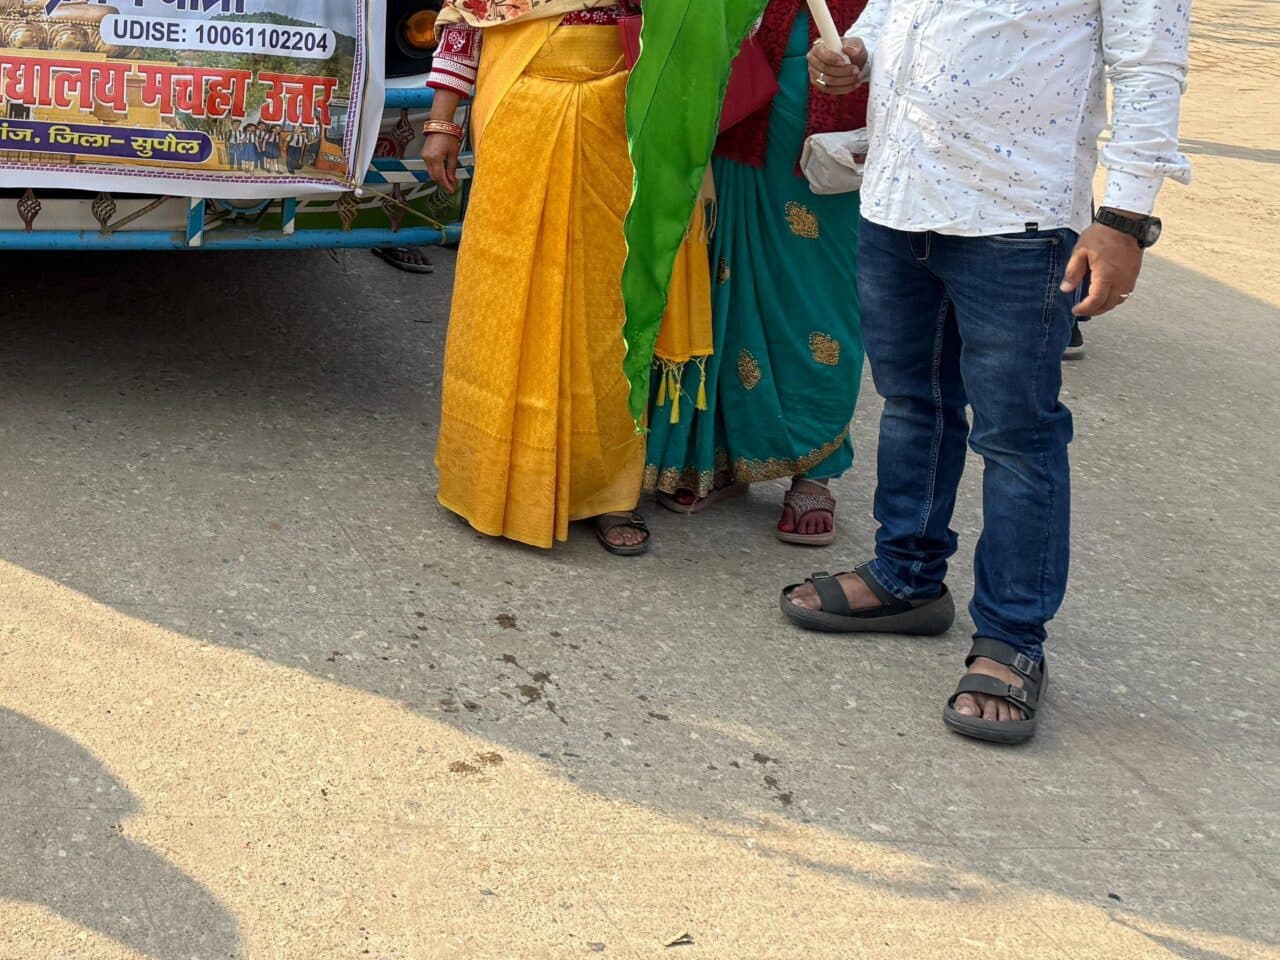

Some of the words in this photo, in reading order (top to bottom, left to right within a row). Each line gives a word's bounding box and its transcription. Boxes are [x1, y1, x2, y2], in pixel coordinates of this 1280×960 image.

[113, 18, 187, 43] UDISE:
[195, 24, 329, 53] 10061102204
[137, 63, 253, 119] मचहा
[258, 71, 338, 128] उत्तर
[131, 130, 204, 158] सुपौल
